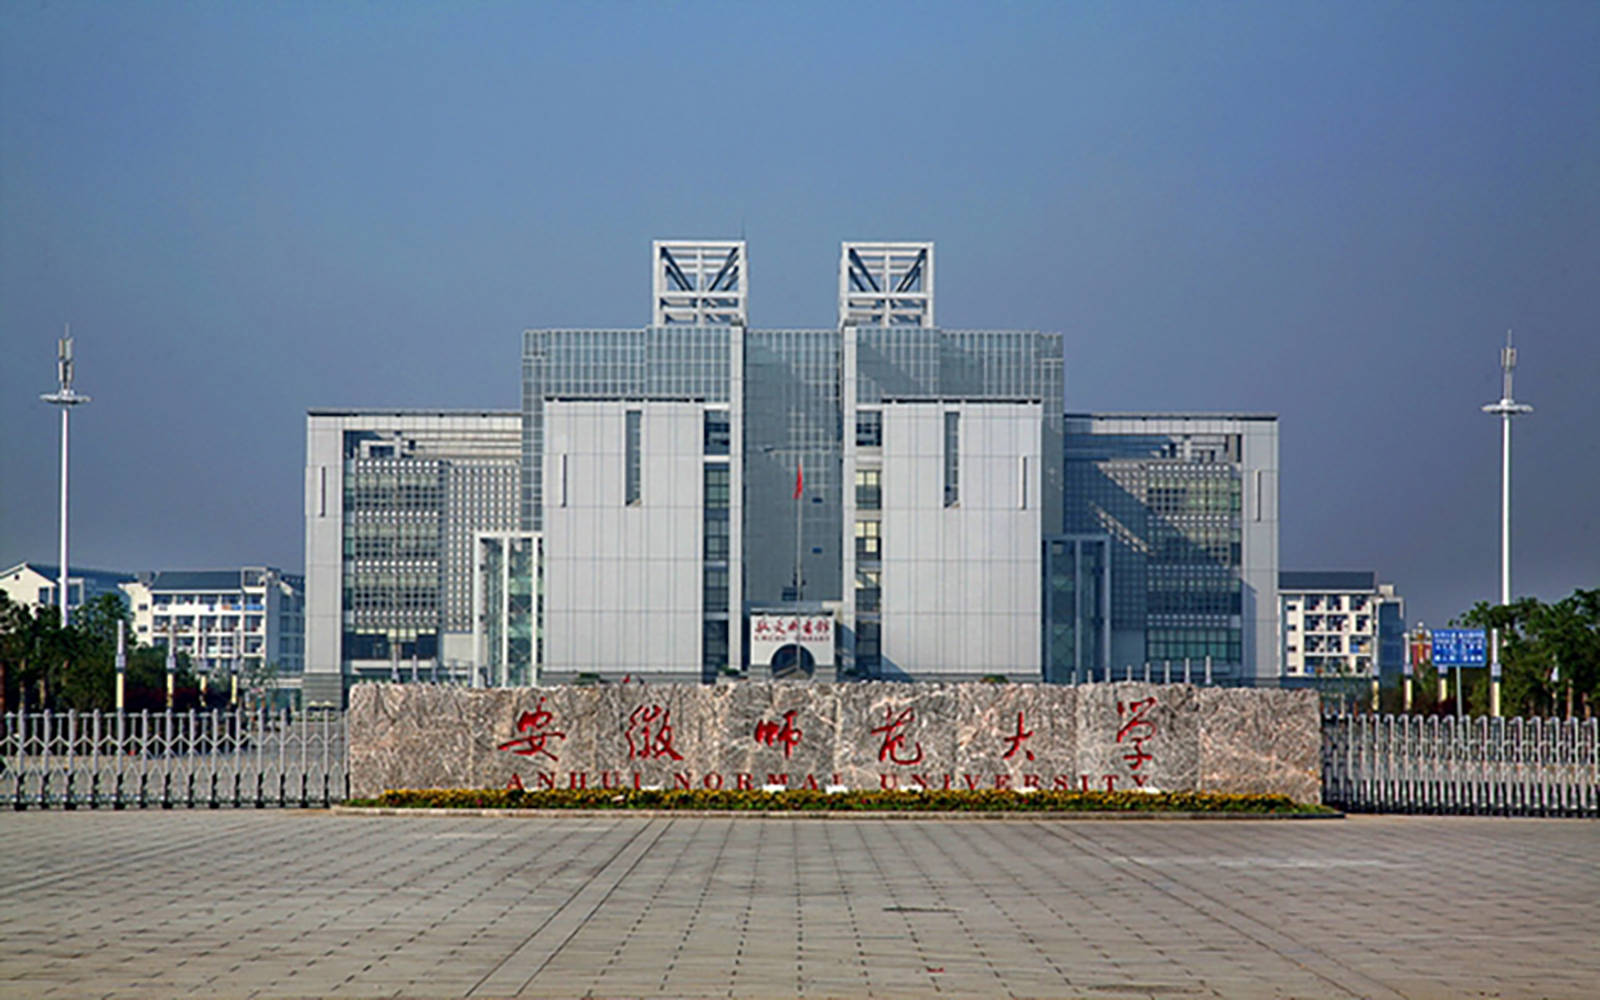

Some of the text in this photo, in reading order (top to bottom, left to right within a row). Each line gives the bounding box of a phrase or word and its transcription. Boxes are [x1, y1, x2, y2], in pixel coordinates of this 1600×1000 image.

[498, 695, 1157, 770] 安徽师范大学
[506, 771, 641, 791] ANHUI
[880, 773, 1150, 793] UNIVERSITY
